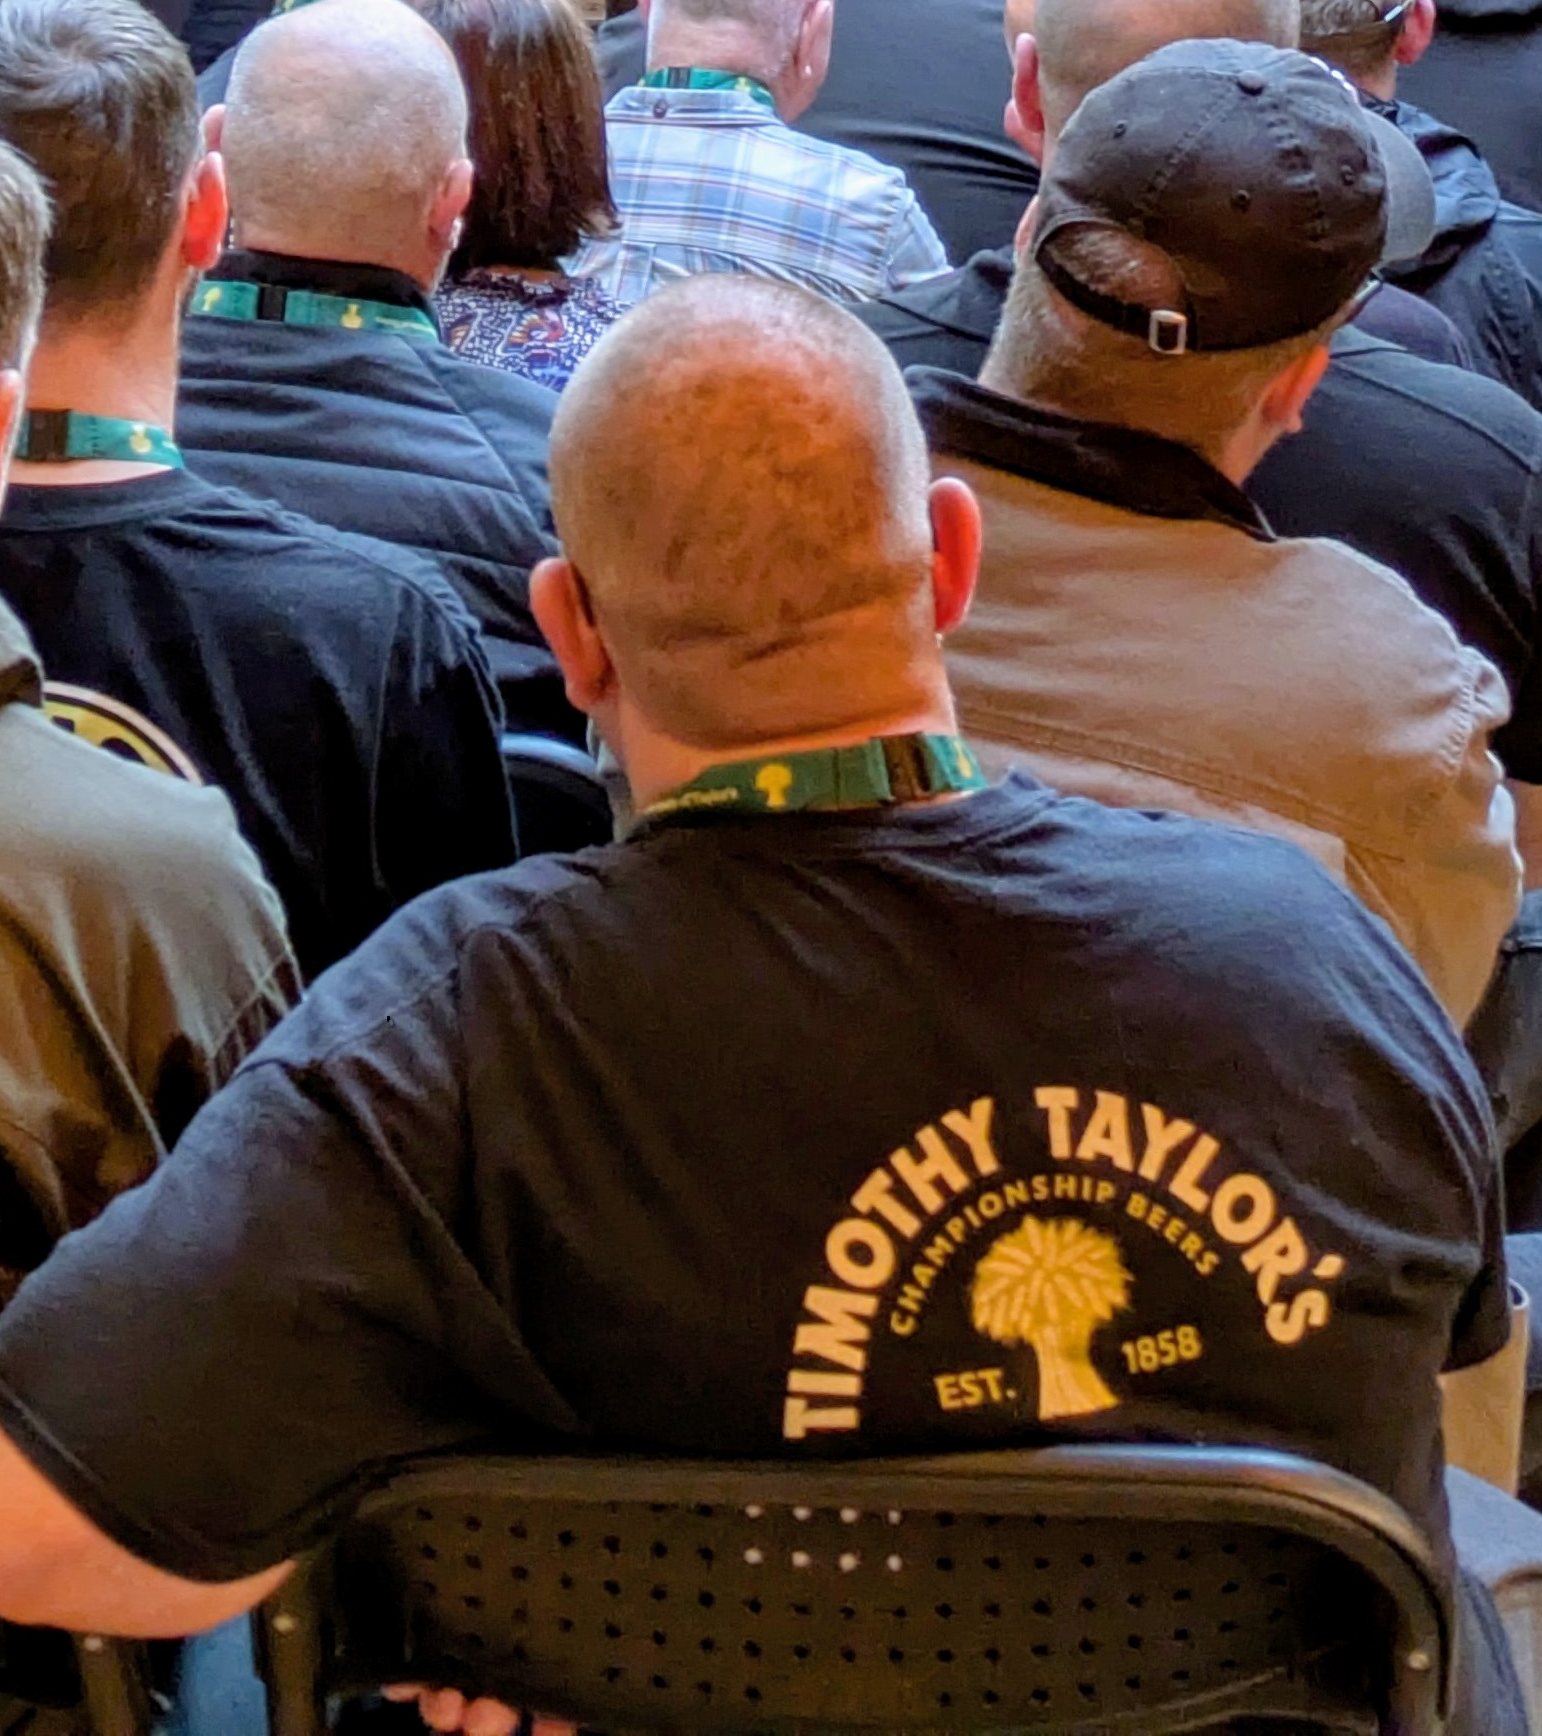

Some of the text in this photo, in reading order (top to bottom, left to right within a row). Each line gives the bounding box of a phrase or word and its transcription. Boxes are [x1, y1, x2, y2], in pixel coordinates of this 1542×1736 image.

[783, 1085, 1346, 1441] TIMOTHY TAYLOR'S
[890, 1173, 1220, 1337] CHAMPIONSHIP BEERS
[934, 1324, 1203, 1411] EST. 1858
